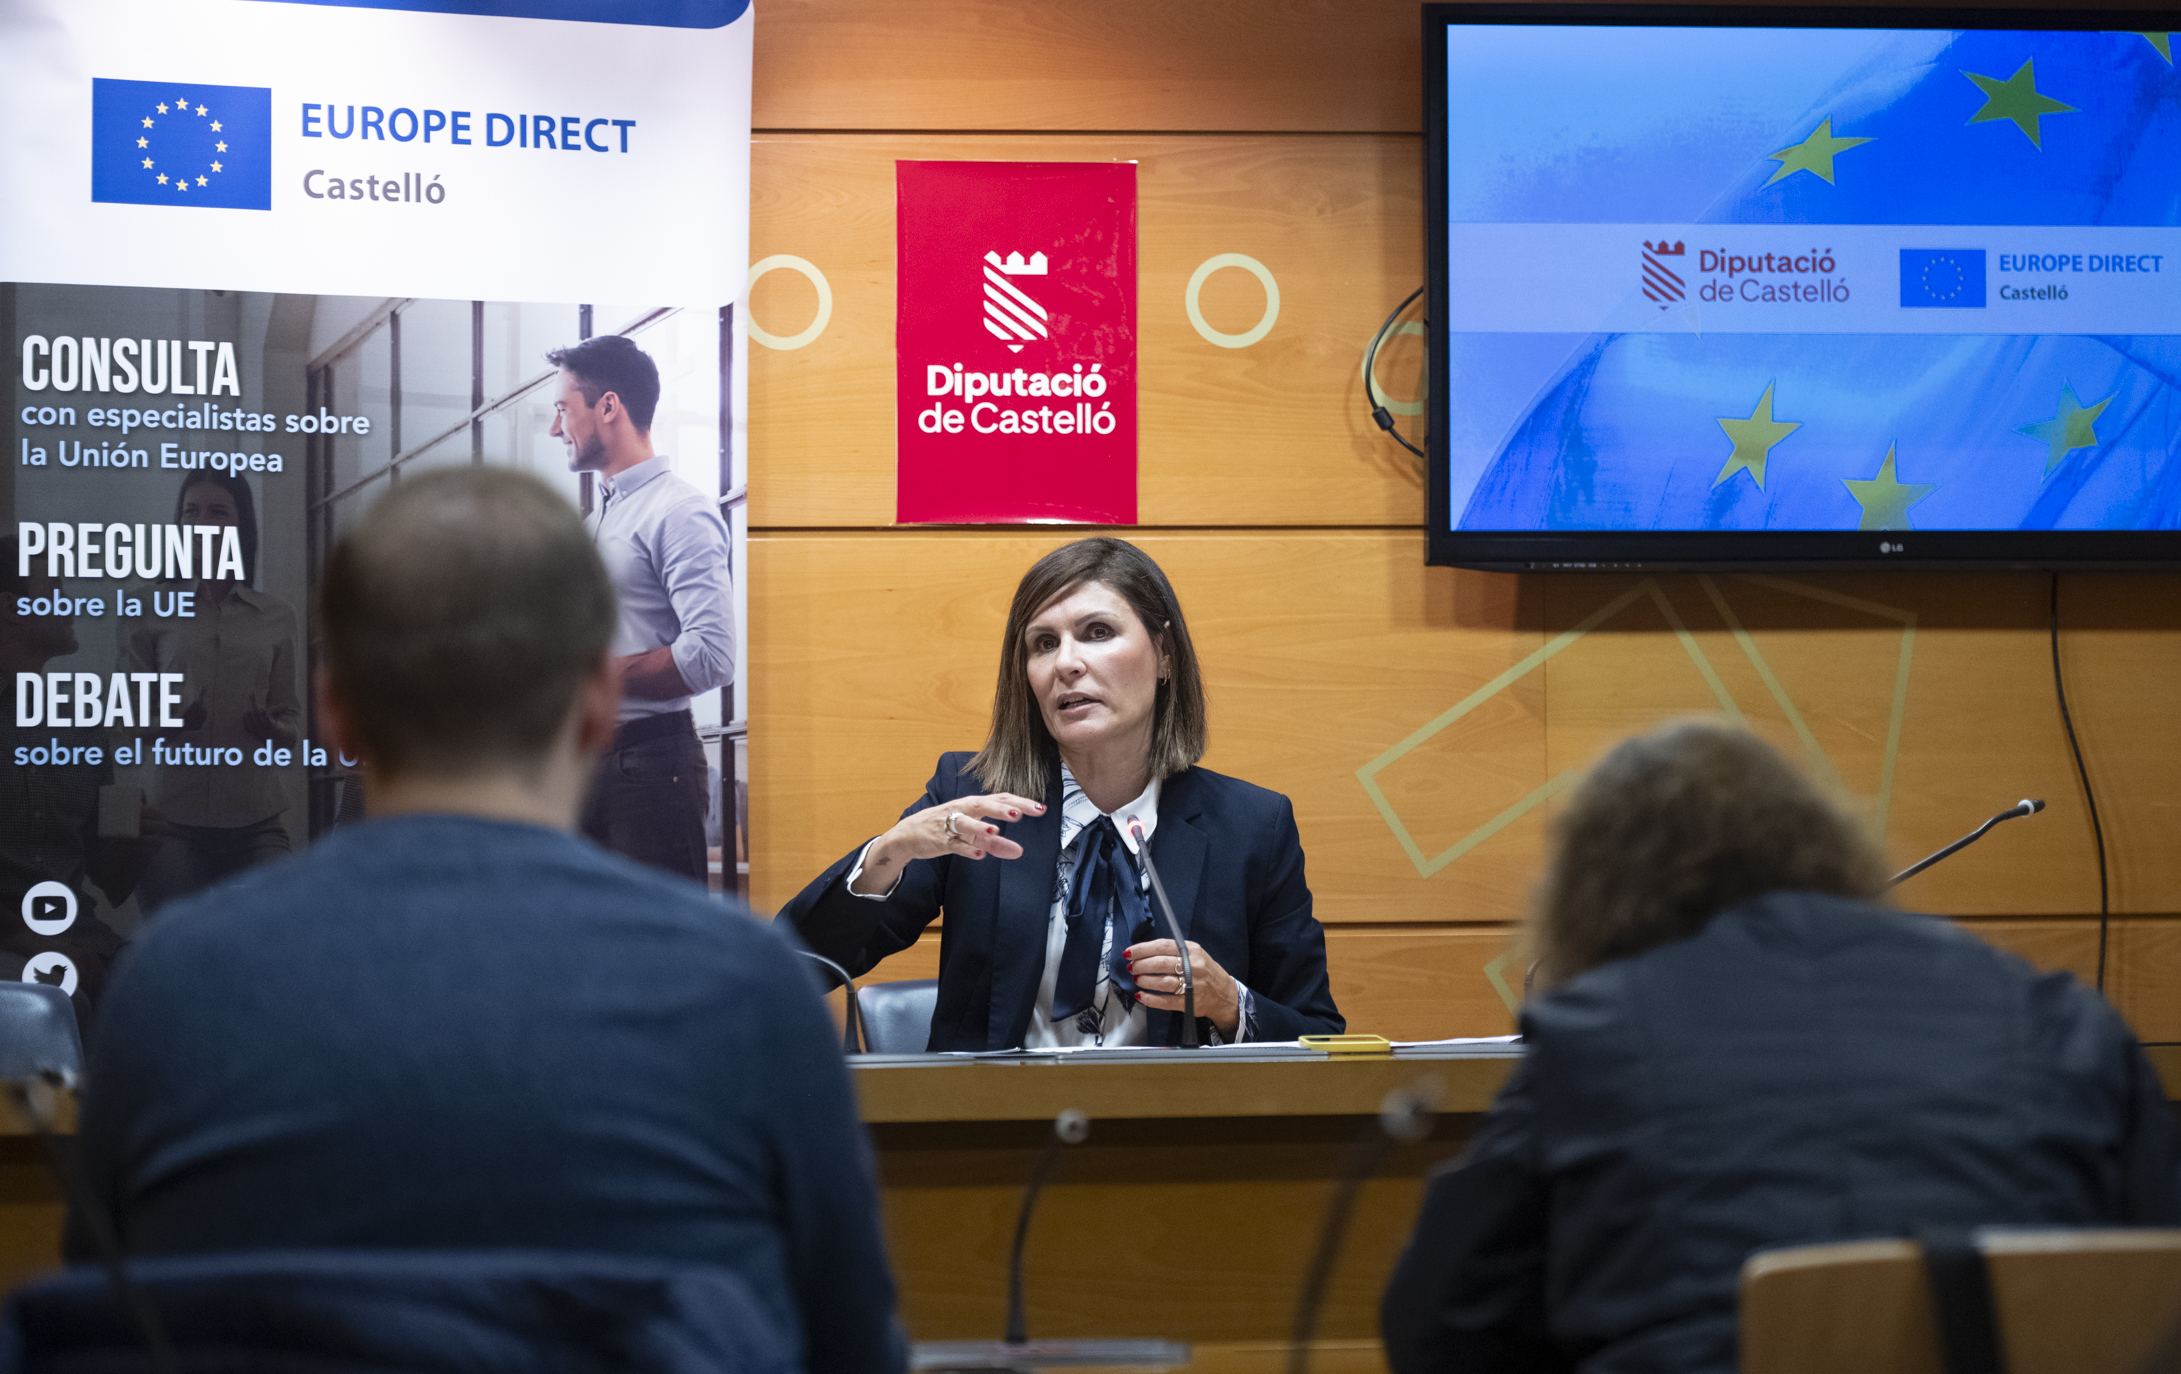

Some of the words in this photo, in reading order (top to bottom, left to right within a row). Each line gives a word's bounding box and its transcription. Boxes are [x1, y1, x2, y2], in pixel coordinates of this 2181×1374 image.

[302, 103, 472, 145] EUROPE
[486, 113, 636, 153] DIRECT
[303, 169, 446, 204] Castelló
[1700, 248, 1835, 280] Diputació
[2000, 254, 2083, 273] EUROPE
[2088, 255, 2164, 273] DIRECT
[1700, 279, 1734, 302] de
[1740, 278, 1850, 302] Castelló
[2000, 284, 2068, 301] Castelló
[22, 334, 241, 396] CONSULTA
[926, 362, 1107, 403] Diputació
[21, 406, 77, 426] con
[87, 402, 276, 434] especialistas
[285, 407, 371, 435] sobre
[918, 402, 965, 433] de
[971, 401, 1116, 435] Castelló
[21, 438, 47, 467] la
[58, 440, 149, 468] Unión
[160, 443, 284, 478] Europea
[18, 522, 245, 580] PREGUNTA
[16, 589, 105, 617] sobre
[116, 590, 143, 617] la
[153, 592, 196, 618] UE
[15, 672, 185, 728] DEBATE
[14, 738, 104, 767] sobre
[114, 738, 142, 766] el
[152, 738, 243, 767] futuro
[253, 739, 292, 767] de
[302, 739, 328, 767] la
